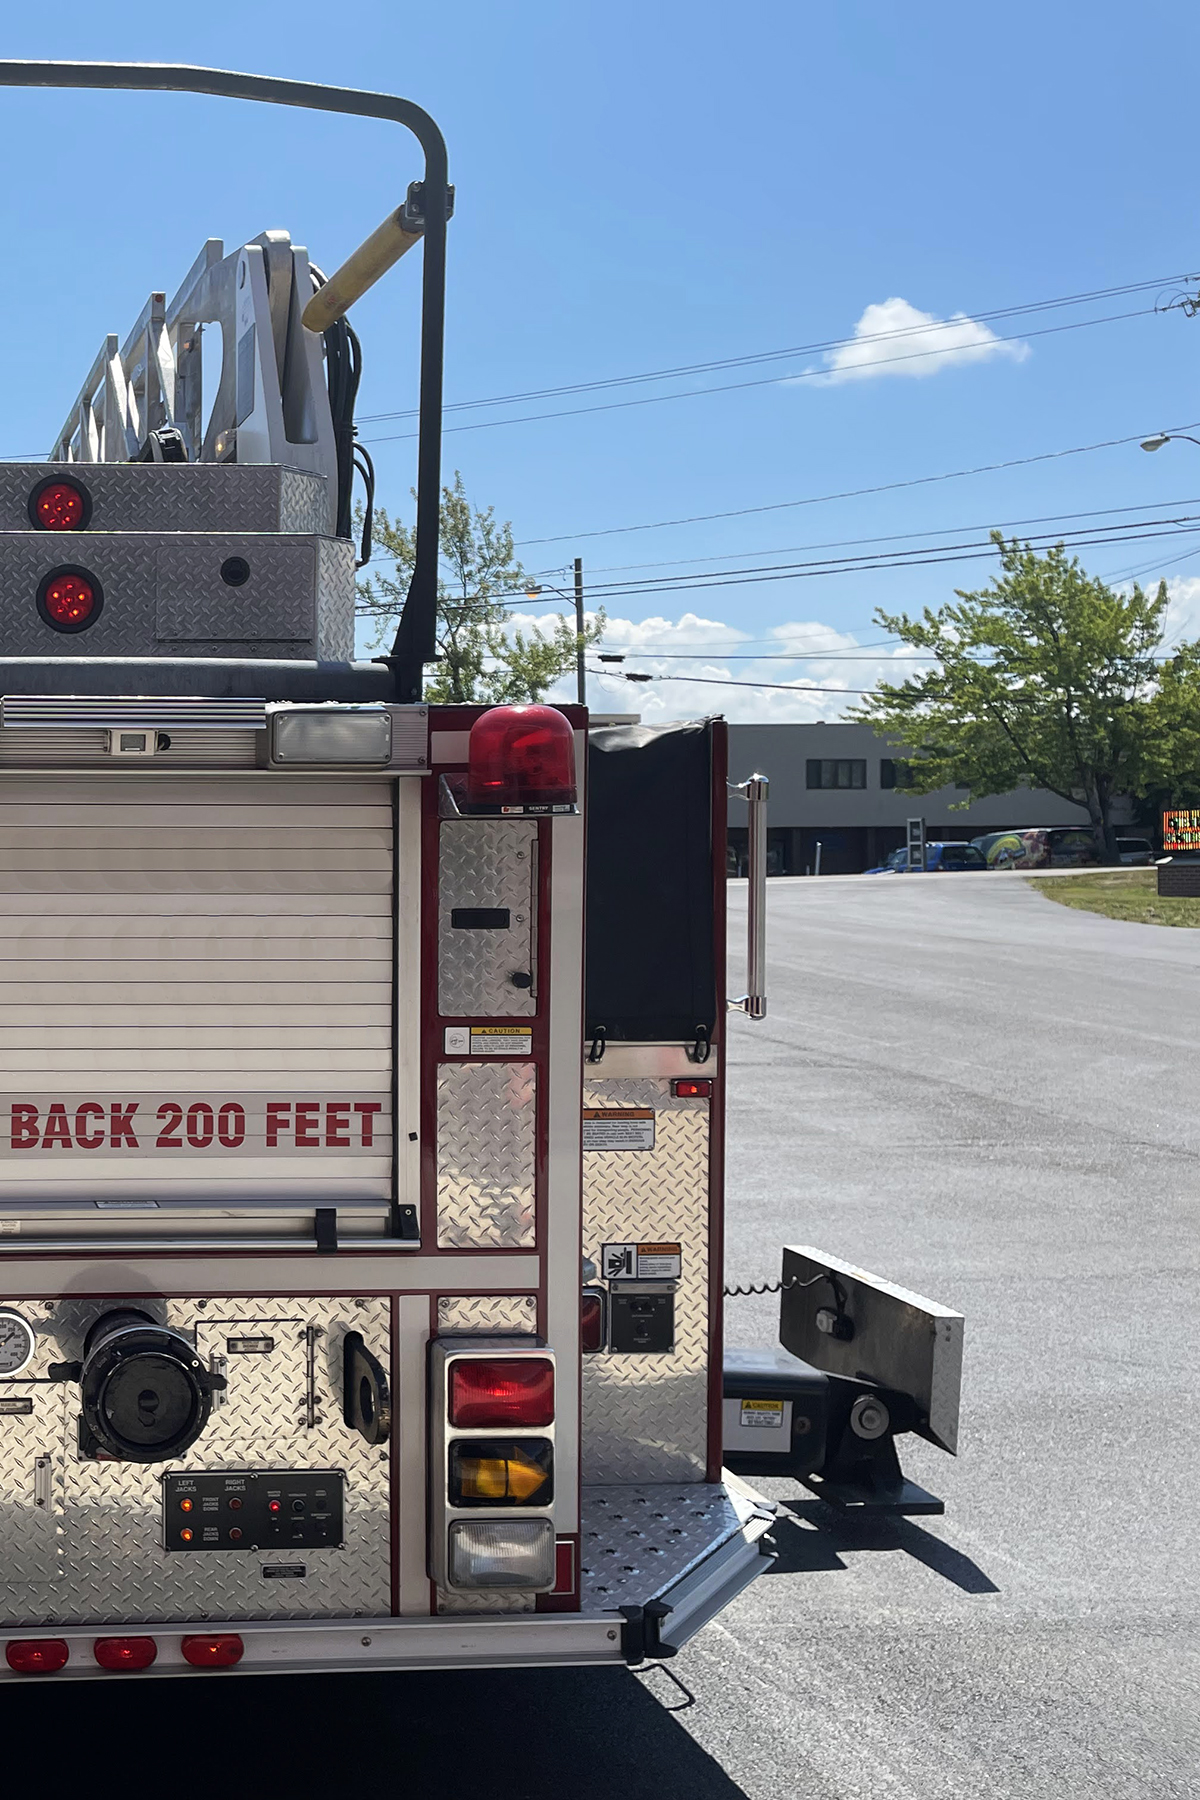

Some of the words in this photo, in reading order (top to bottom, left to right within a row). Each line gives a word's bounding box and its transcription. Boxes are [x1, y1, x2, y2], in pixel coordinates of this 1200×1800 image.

[10, 1102, 140, 1149] BACK
[155, 1102, 246, 1148] 200
[265, 1102, 382, 1147] FEET
